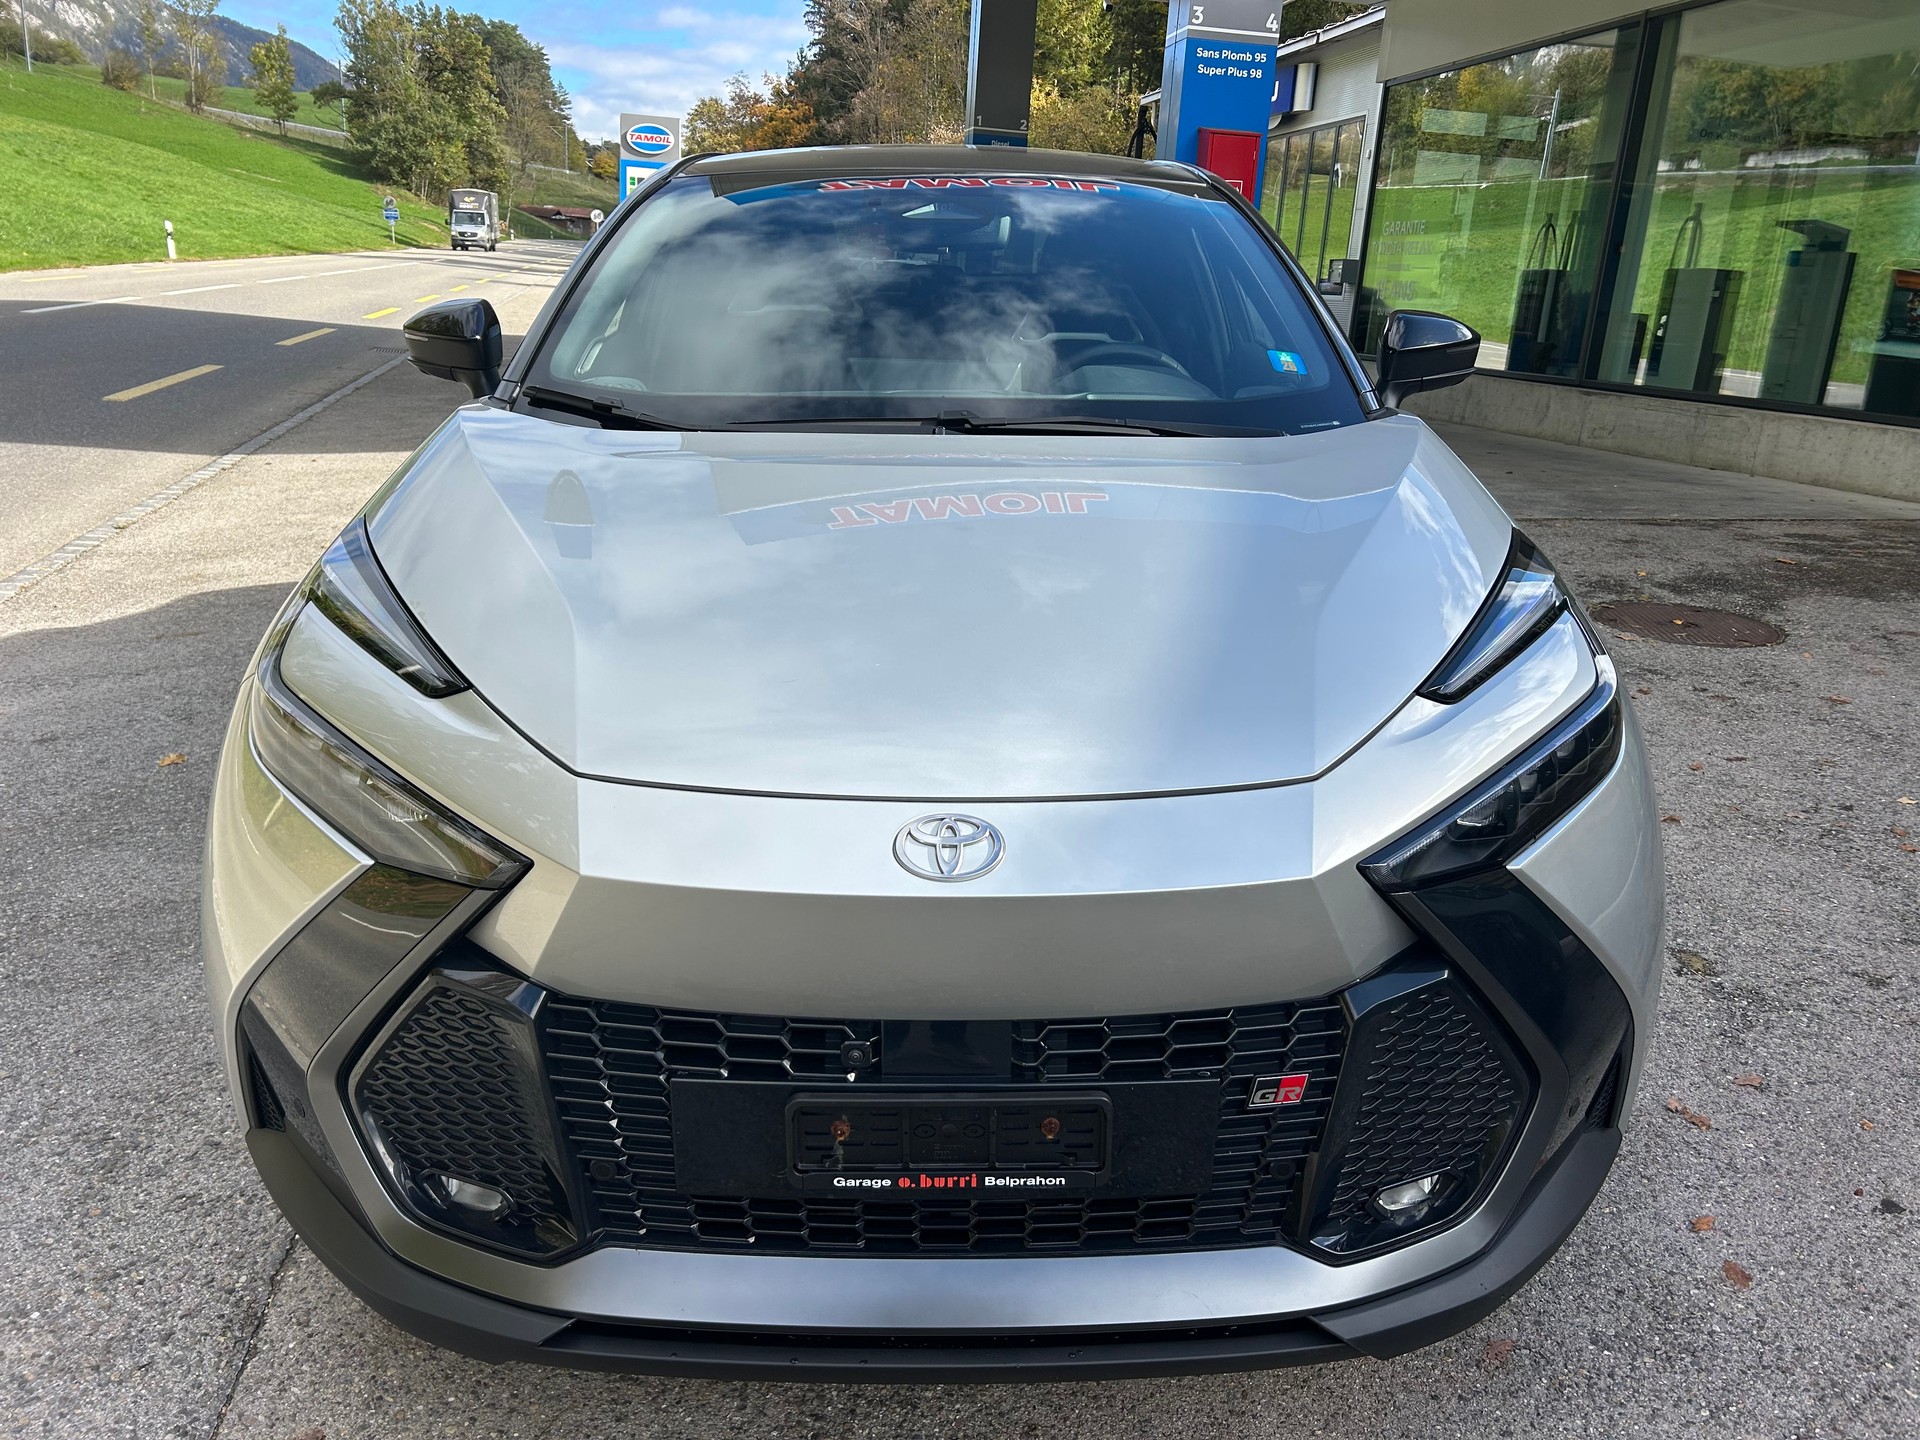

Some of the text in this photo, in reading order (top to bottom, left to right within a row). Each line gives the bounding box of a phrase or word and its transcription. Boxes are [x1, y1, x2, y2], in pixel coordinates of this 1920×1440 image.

[1191, 5, 1204, 25] 3
[1265, 12, 1279, 32] 4
[1196, 47, 1267, 63] Sans Plomb 95
[1197, 63, 1263, 79] Super Plus 98
[976, 115, 982, 126] 1
[1019, 119, 1028, 130] 2
[628, 133, 672, 144] TAMOIL
[1382, 219, 1426, 236] GARANTIE
[1253, 1086, 1301, 1104] GR
[832, 1176, 892, 1188] Garage
[984, 1175, 1066, 1187] Belprahon
